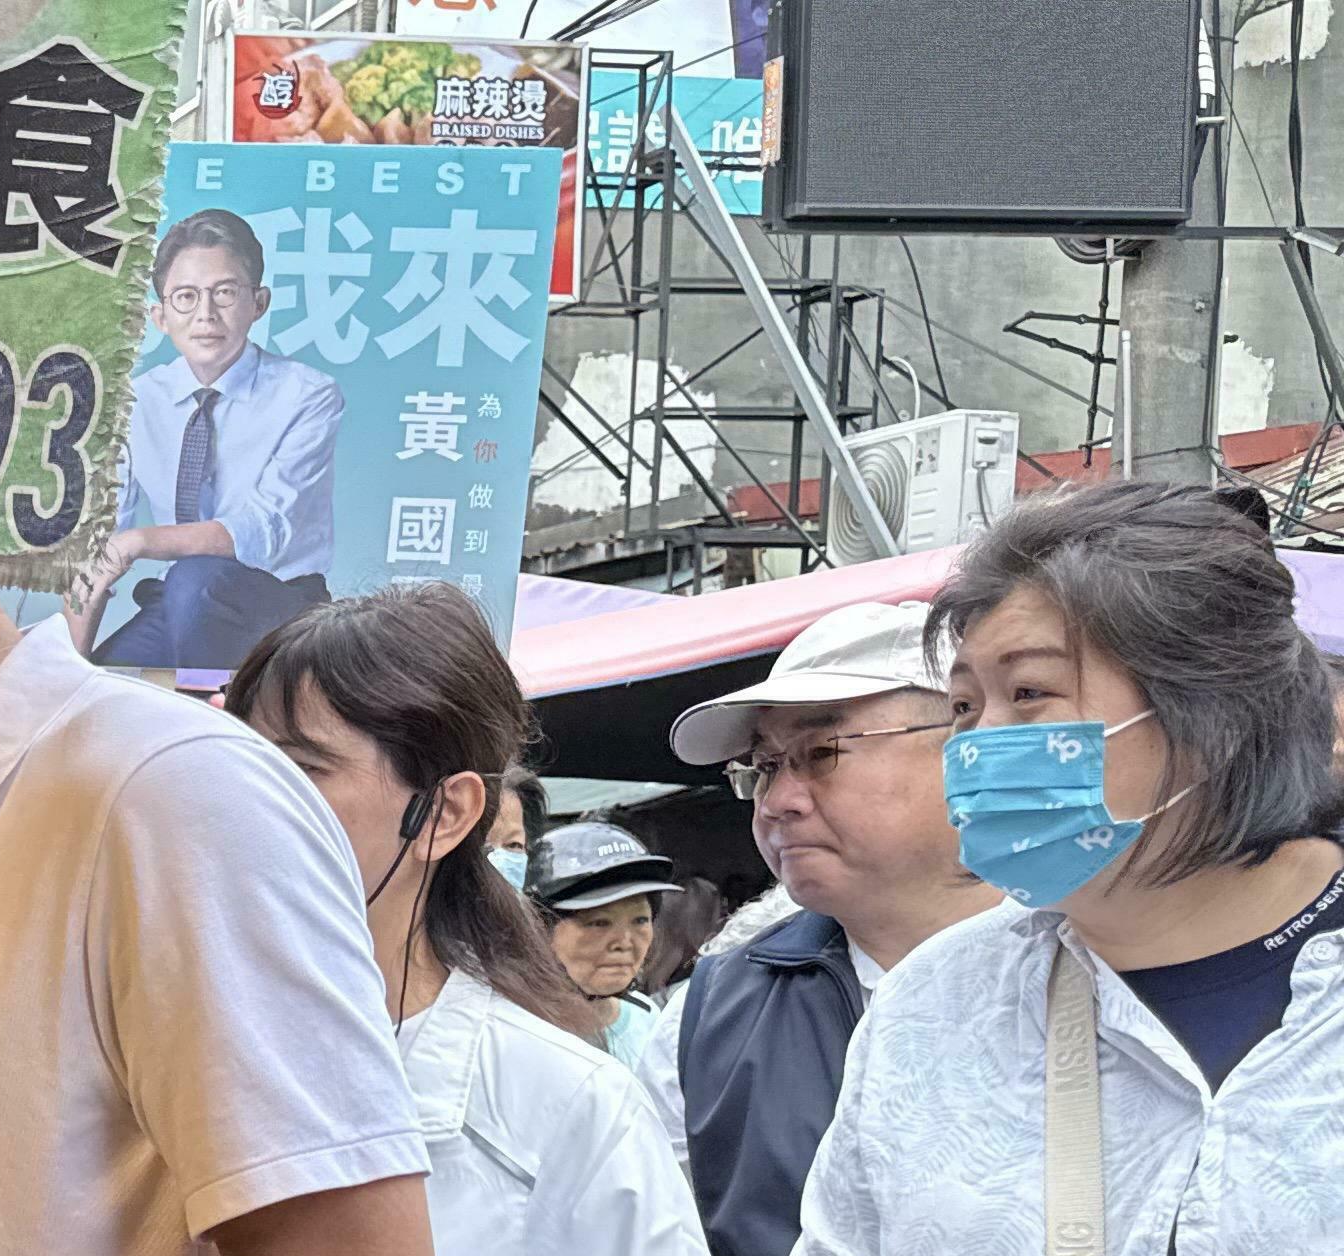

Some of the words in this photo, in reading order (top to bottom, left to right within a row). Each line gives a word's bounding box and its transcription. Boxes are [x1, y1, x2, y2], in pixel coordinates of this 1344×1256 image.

[434, 78, 548, 121] 麻辣燙
[432, 122, 492, 138] BRAISED
[495, 124, 545, 140] DISHES
[305, 160, 533, 197] BEST
[387, 391, 468, 582] 黃國
